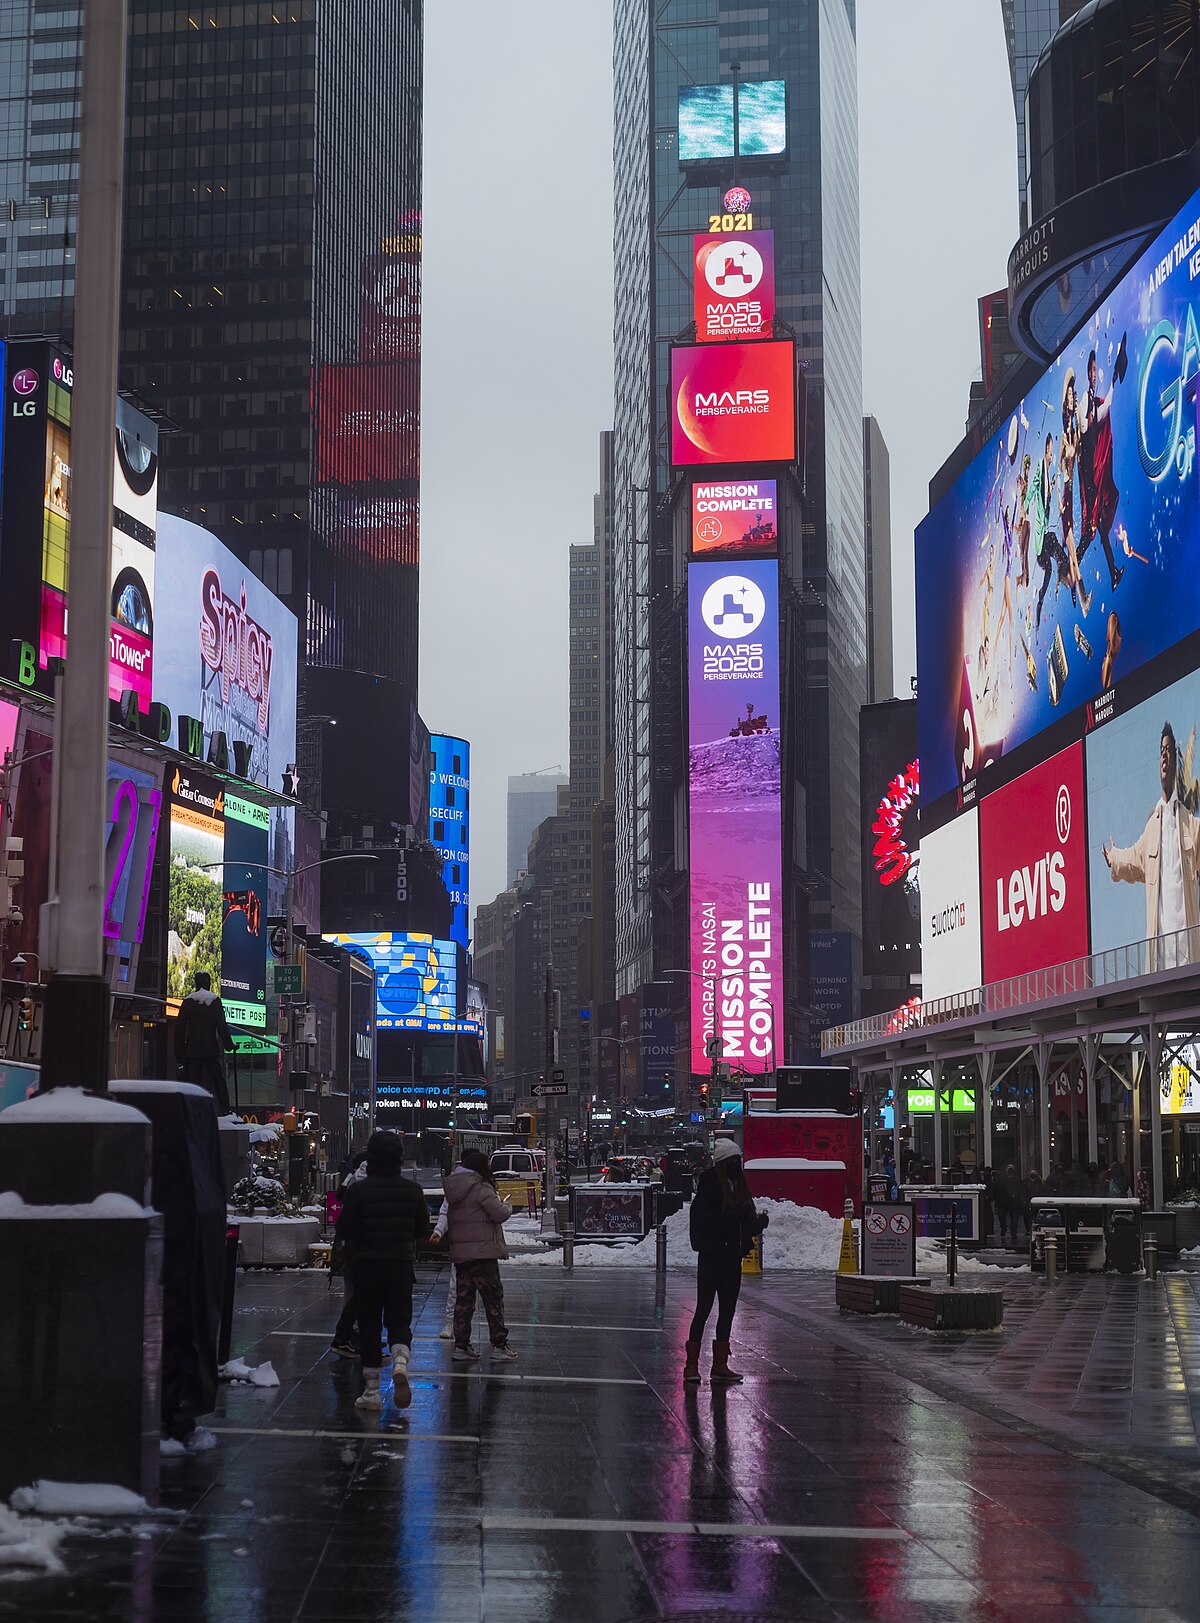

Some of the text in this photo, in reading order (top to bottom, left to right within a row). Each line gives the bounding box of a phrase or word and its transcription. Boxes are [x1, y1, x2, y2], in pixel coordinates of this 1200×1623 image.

[709, 213, 753, 232] 2021
[1155, 249, 1174, 289] NEW
[707, 301, 761, 314] MARS
[707, 313, 761, 328] 2020
[707, 327, 761, 335] PERSEVERANCE
[695, 389, 770, 407] MARS
[13, 401, 36, 417] LG
[695, 405, 770, 416] PERSEVERANCE
[696, 485, 758, 498] MISSION
[696, 498, 773, 513] COMPLETE
[703, 643, 764, 657] MARS
[703, 656, 764, 673] 2020
[703, 672, 764, 680] PERSEVERANCE
[1094, 689, 1116, 710] MARRIOTT
[1095, 704, 1114, 723] MARQUIS
[397, 850, 407, 901] 1500
[186, 904, 206, 925] travel
[931, 899, 960, 938] swatch
[702, 902, 716, 954] NASA!
[748, 881, 773, 1058] COMPLETE
[721, 920, 744, 1058] MISSION
[377, 1085, 401, 1094] voice
